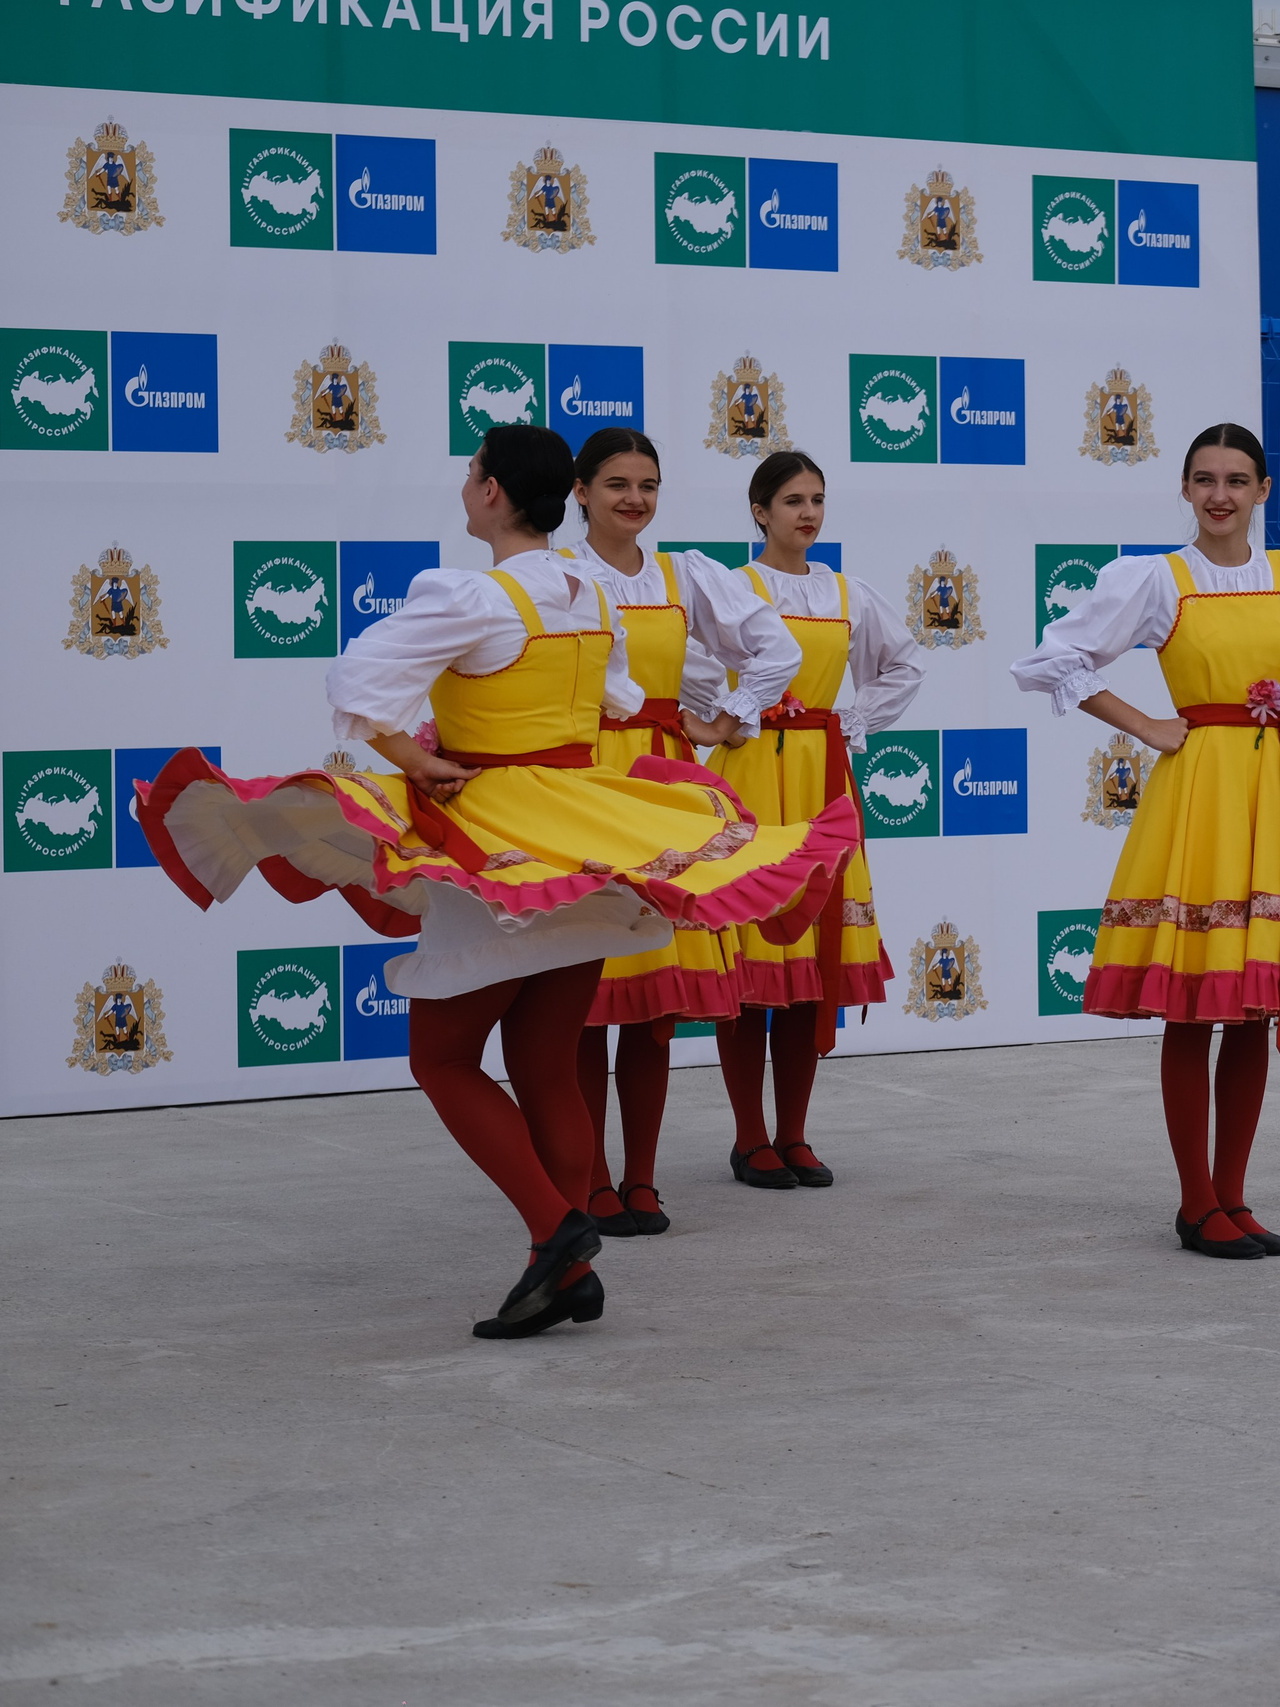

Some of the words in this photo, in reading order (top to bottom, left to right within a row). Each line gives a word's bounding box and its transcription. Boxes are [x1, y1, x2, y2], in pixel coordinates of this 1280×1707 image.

[60, 0, 553, 42] ИКАЦИЯ
[579, 0, 830, 60] РОССИИ
[249, 147, 312, 173] ГАЗИФИКАЦИЯ
[671, 170, 728, 194] ГАЗИФИКАЦИЯ
[1048, 192, 1099, 214] ГАЗИФИКАЦИЯ
[260, 221, 302, 235] РОССИИ
[682, 239, 719, 253] РОССИИ
[1057, 258, 1090, 270] РОССИИ
[19, 346, 87, 372] ГАЗИФИКАЦИЯ
[467, 358, 527, 382] ГАЗИФИКАЦИЯ
[865, 370, 920, 393] ГАЗИФИКАЦИЯ
[32, 424, 75, 436] РОССИИ
[876, 438, 911, 450] РОССИИ
[253, 557, 317, 582] ГАЗИФИКАЦИЯ
[1050, 558, 1100, 580] ГАЗИФИКАЦИ
[375, 598, 406, 614] ГАЗП
[265, 632, 305, 644] РОССИИ
[868, 745, 923, 768] ГАЗИФИКАЦИЯ
[24, 767, 91, 791] ГАЗИФИКАЦИЯ
[878, 814, 913, 826] РОССИИ
[35, 843, 79, 857] РОССИИ
[1053, 924, 1098, 946] ГАЗИФИКАЦ
[256, 964, 320, 989] ГАЗИФИКАЦИЯ
[379, 999, 410, 1016] ГАЗПР
[1062, 991, 1084, 1002] РОСС
[268, 1037, 309, 1051] РОССИИ
